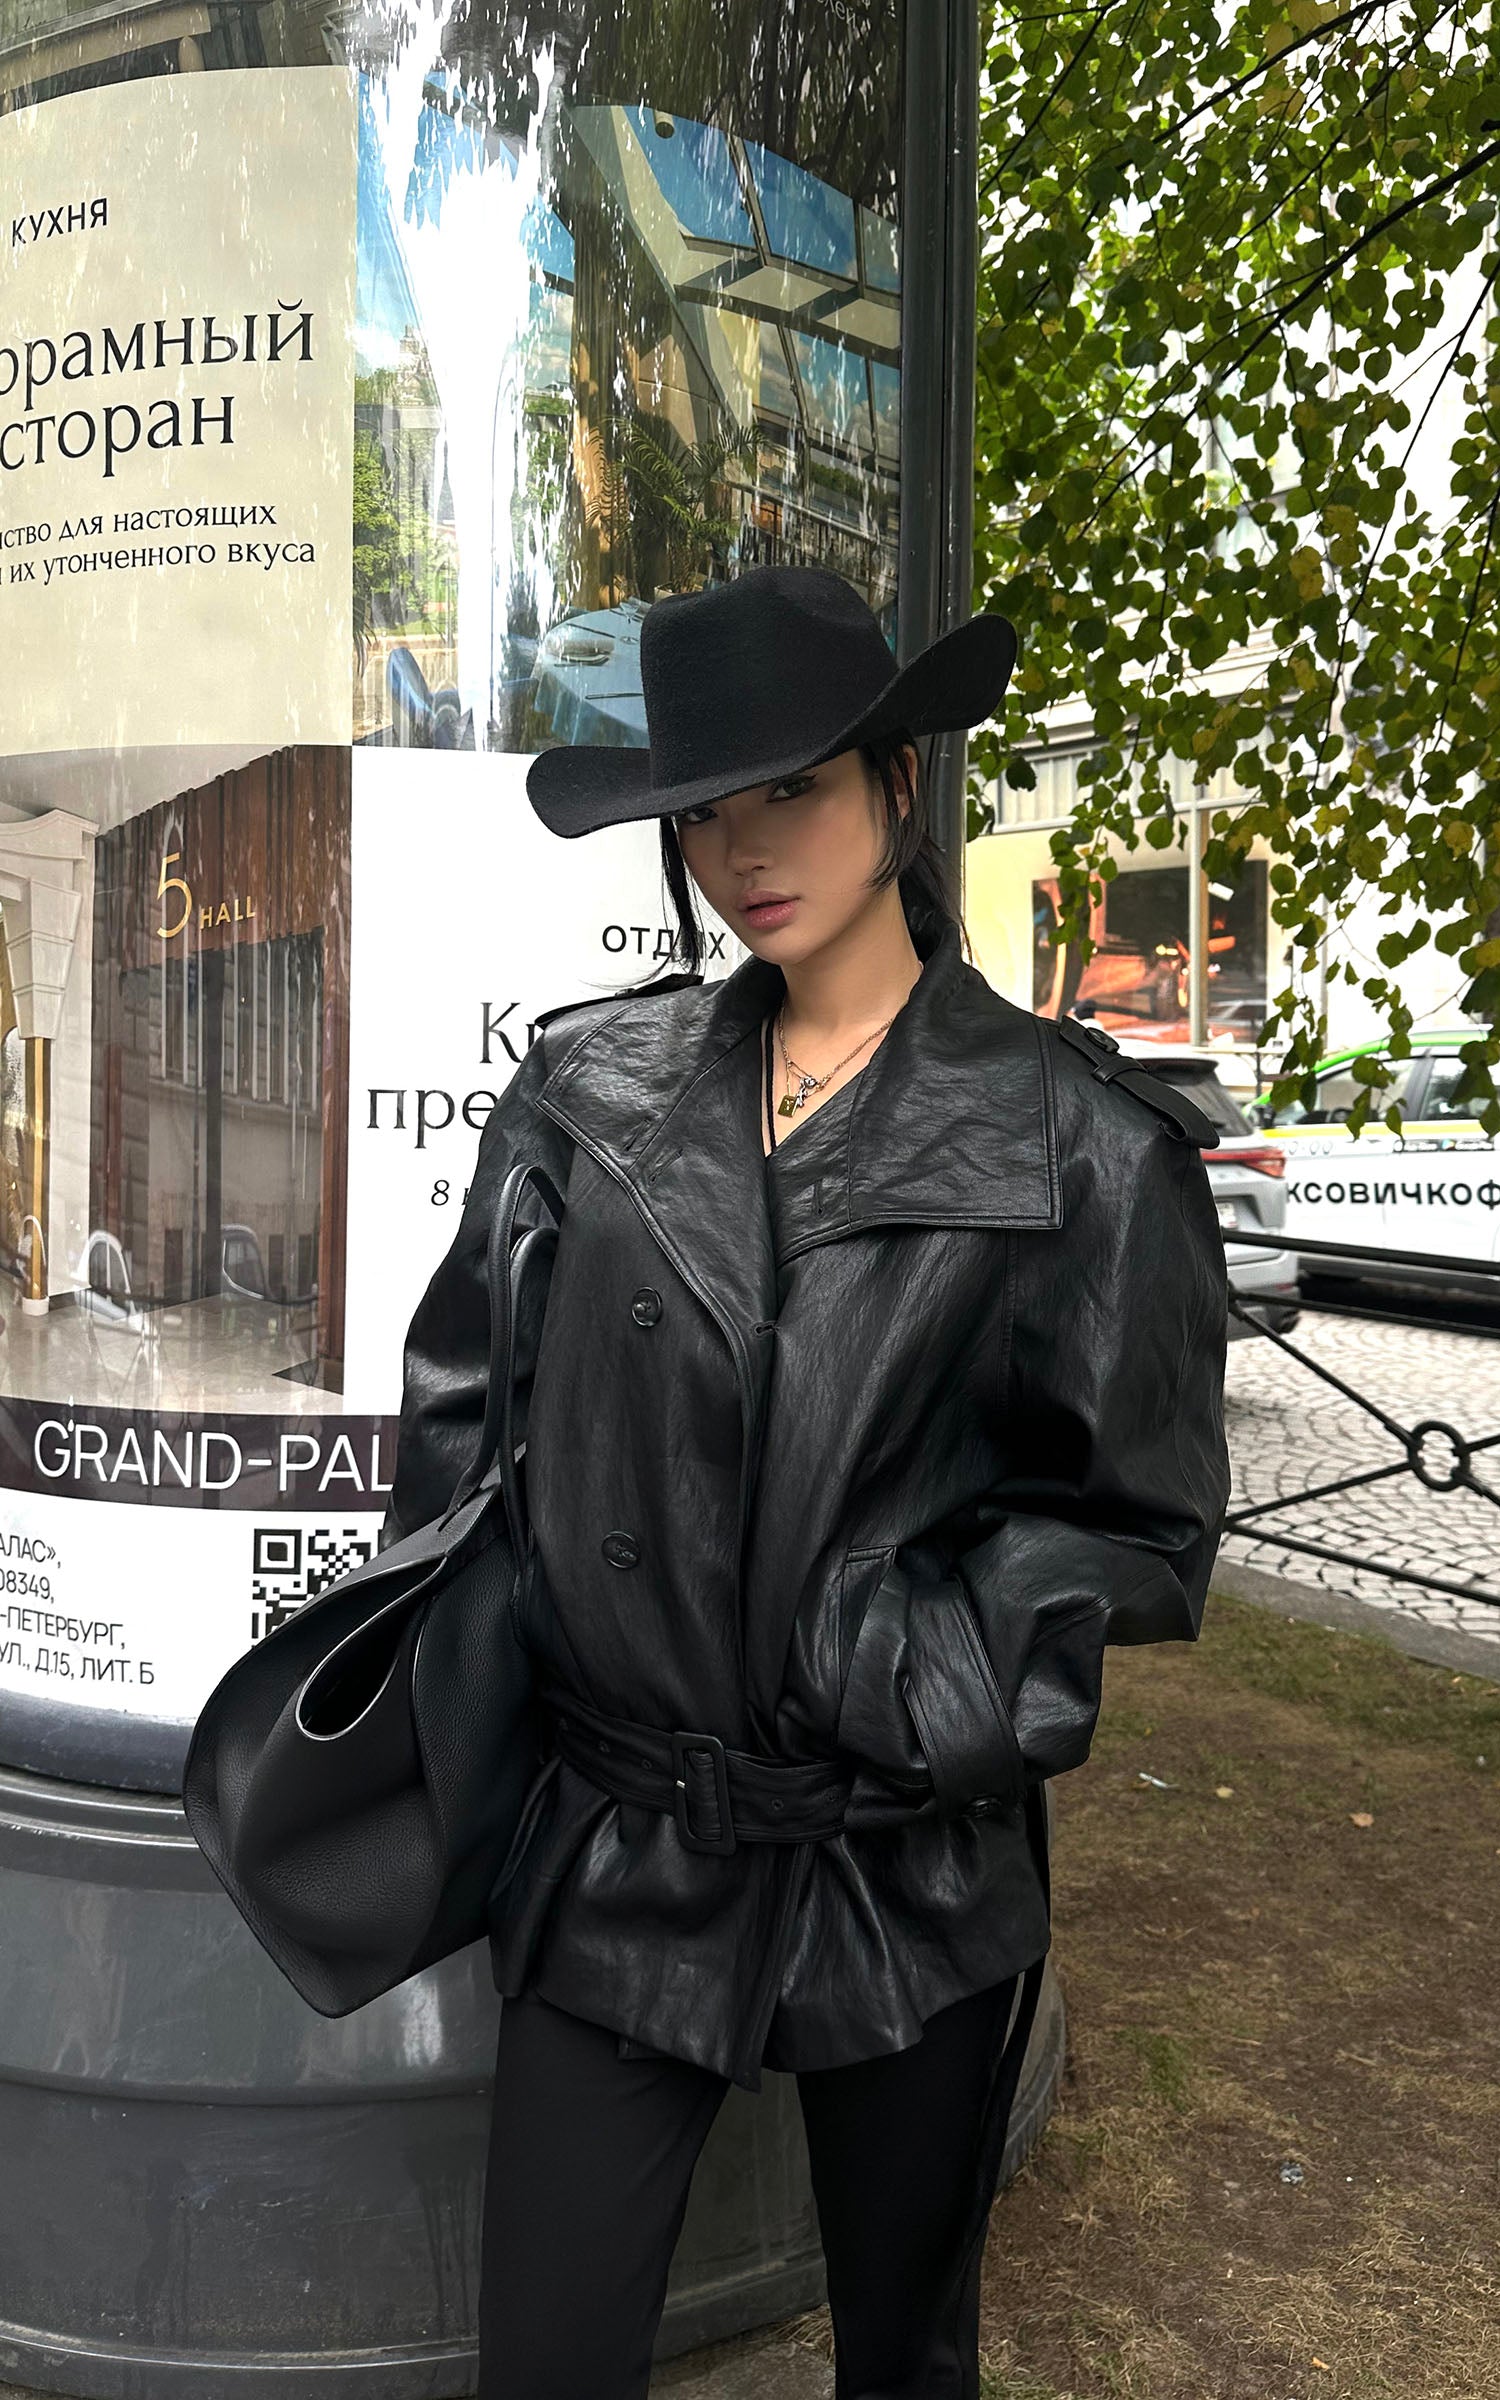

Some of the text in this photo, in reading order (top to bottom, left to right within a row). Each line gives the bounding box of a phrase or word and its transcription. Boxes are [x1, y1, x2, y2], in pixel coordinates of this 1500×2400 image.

[12, 197, 107, 248] КУХНЯ
[0, 395, 235, 478] сторан
[58, 515, 103, 542] для
[113, 505, 277, 533] настоящих
[10, 561, 36, 584] их
[43, 541, 216, 586] утонченного
[228, 543, 315, 571] вкуса
[157, 852, 256, 938] 5 HALL
[431, 1179, 449, 1206] 8
[80, 1656, 133, 1683] ЛИТ.
[140, 1661, 155, 1685] Б
